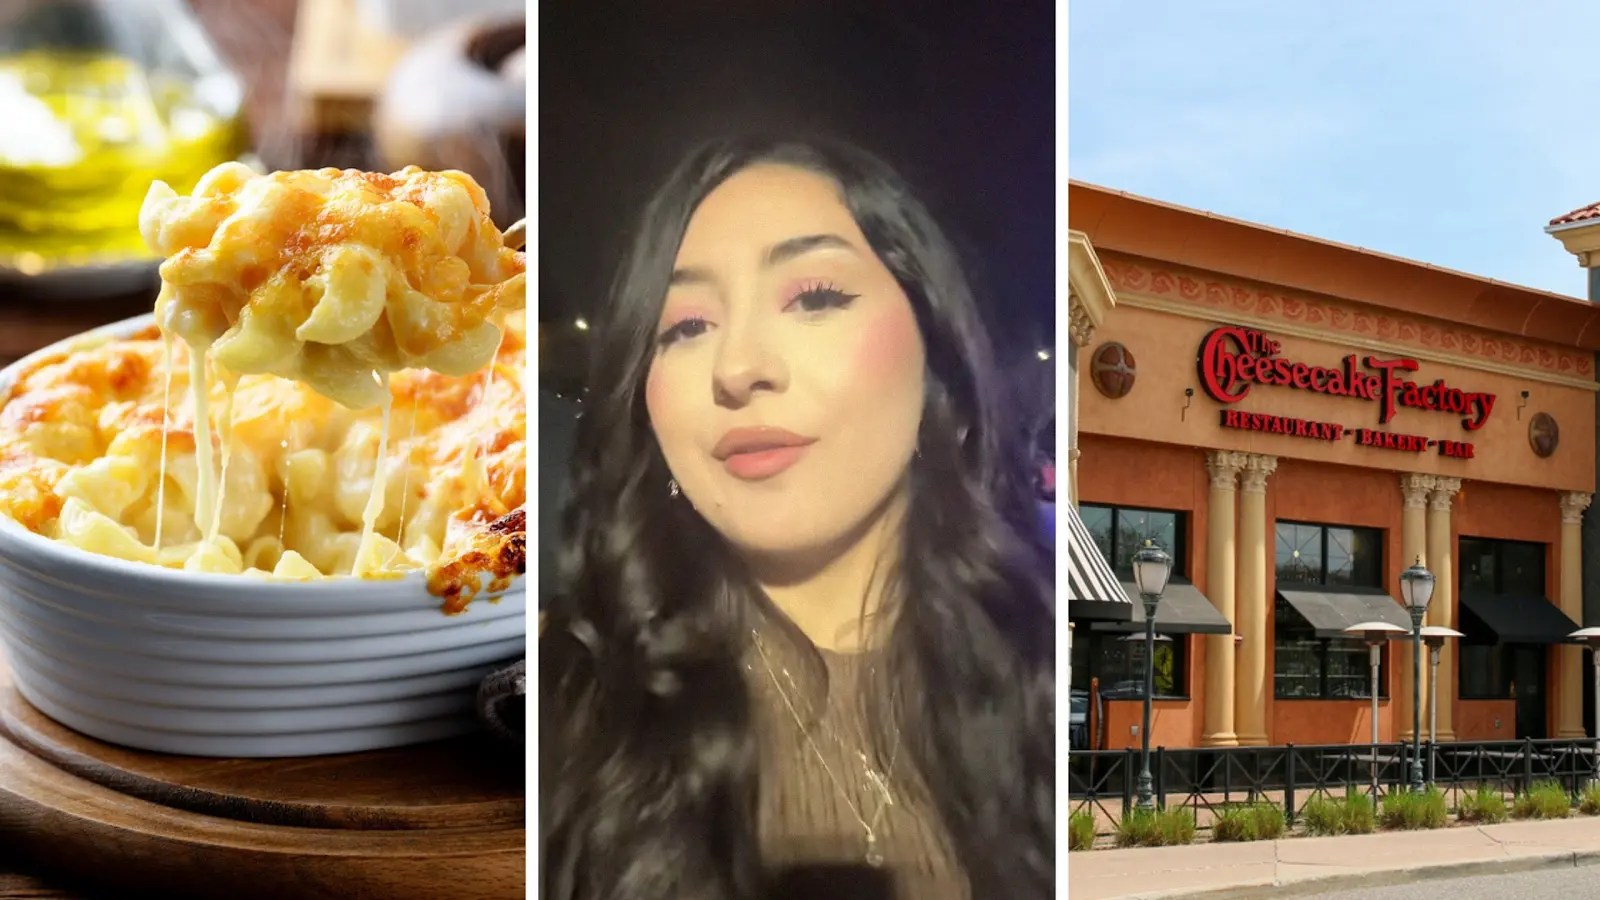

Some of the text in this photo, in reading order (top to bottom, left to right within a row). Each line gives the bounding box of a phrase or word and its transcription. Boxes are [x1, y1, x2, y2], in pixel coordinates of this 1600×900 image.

[1249, 330, 1281, 354] The
[1200, 326, 1496, 430] Cheesecake Factory
[1222, 410, 1475, 458] RESTAURANT BAKERY BAR
